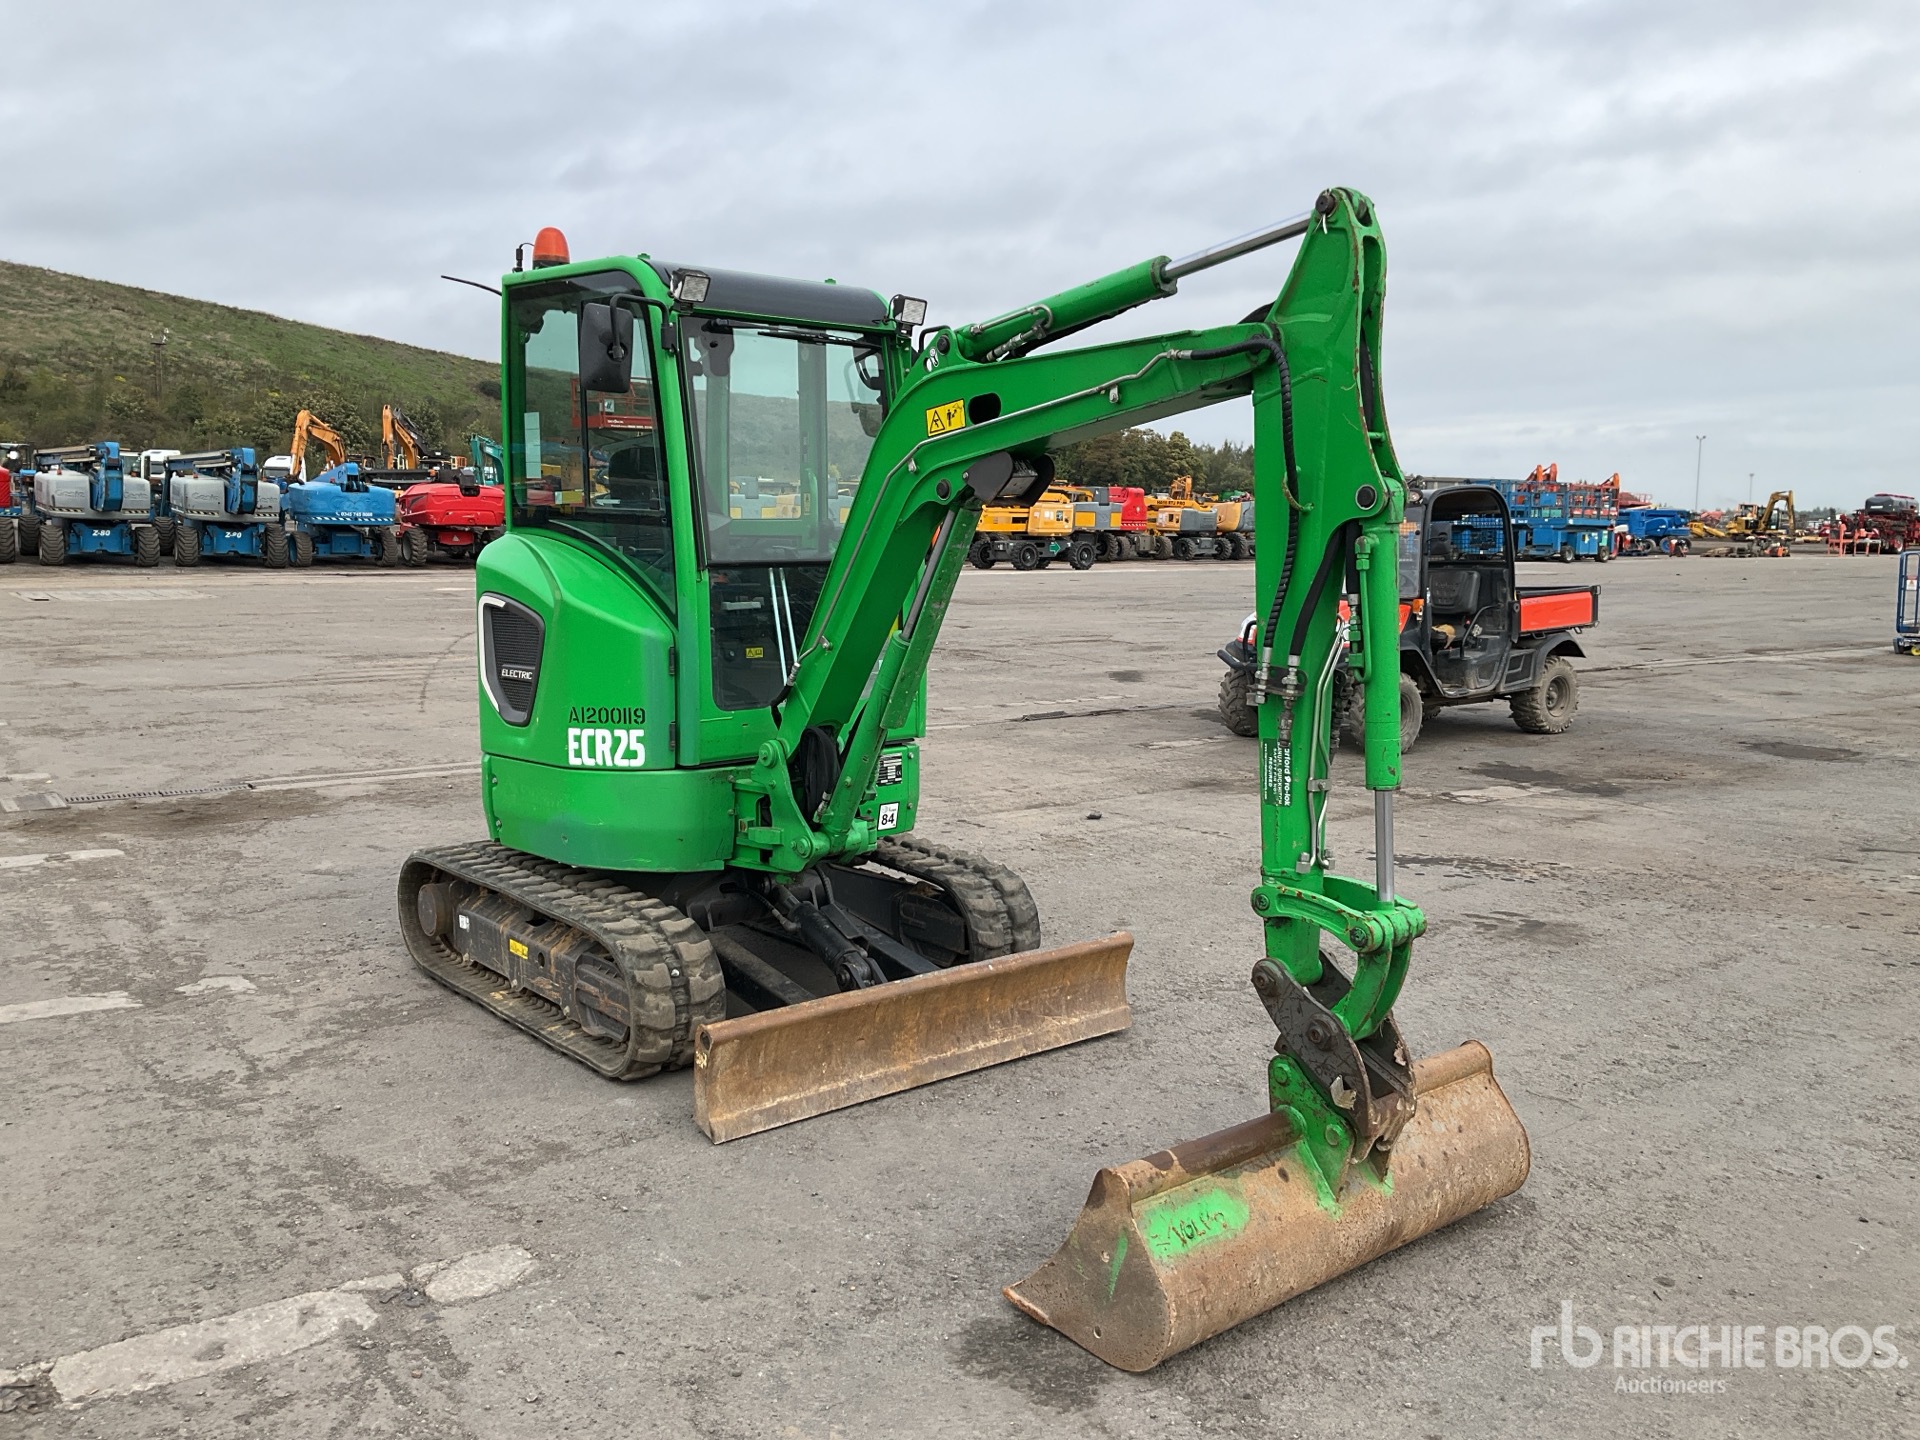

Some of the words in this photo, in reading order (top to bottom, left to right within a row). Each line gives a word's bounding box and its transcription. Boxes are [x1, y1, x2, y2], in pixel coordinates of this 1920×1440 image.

[92, 529, 111, 537] Z-80
[501, 668, 533, 680] ELECTRIC
[568, 706, 646, 725] A1200119
[567, 727, 646, 767] ECR25
[881, 812, 895, 826] 84
